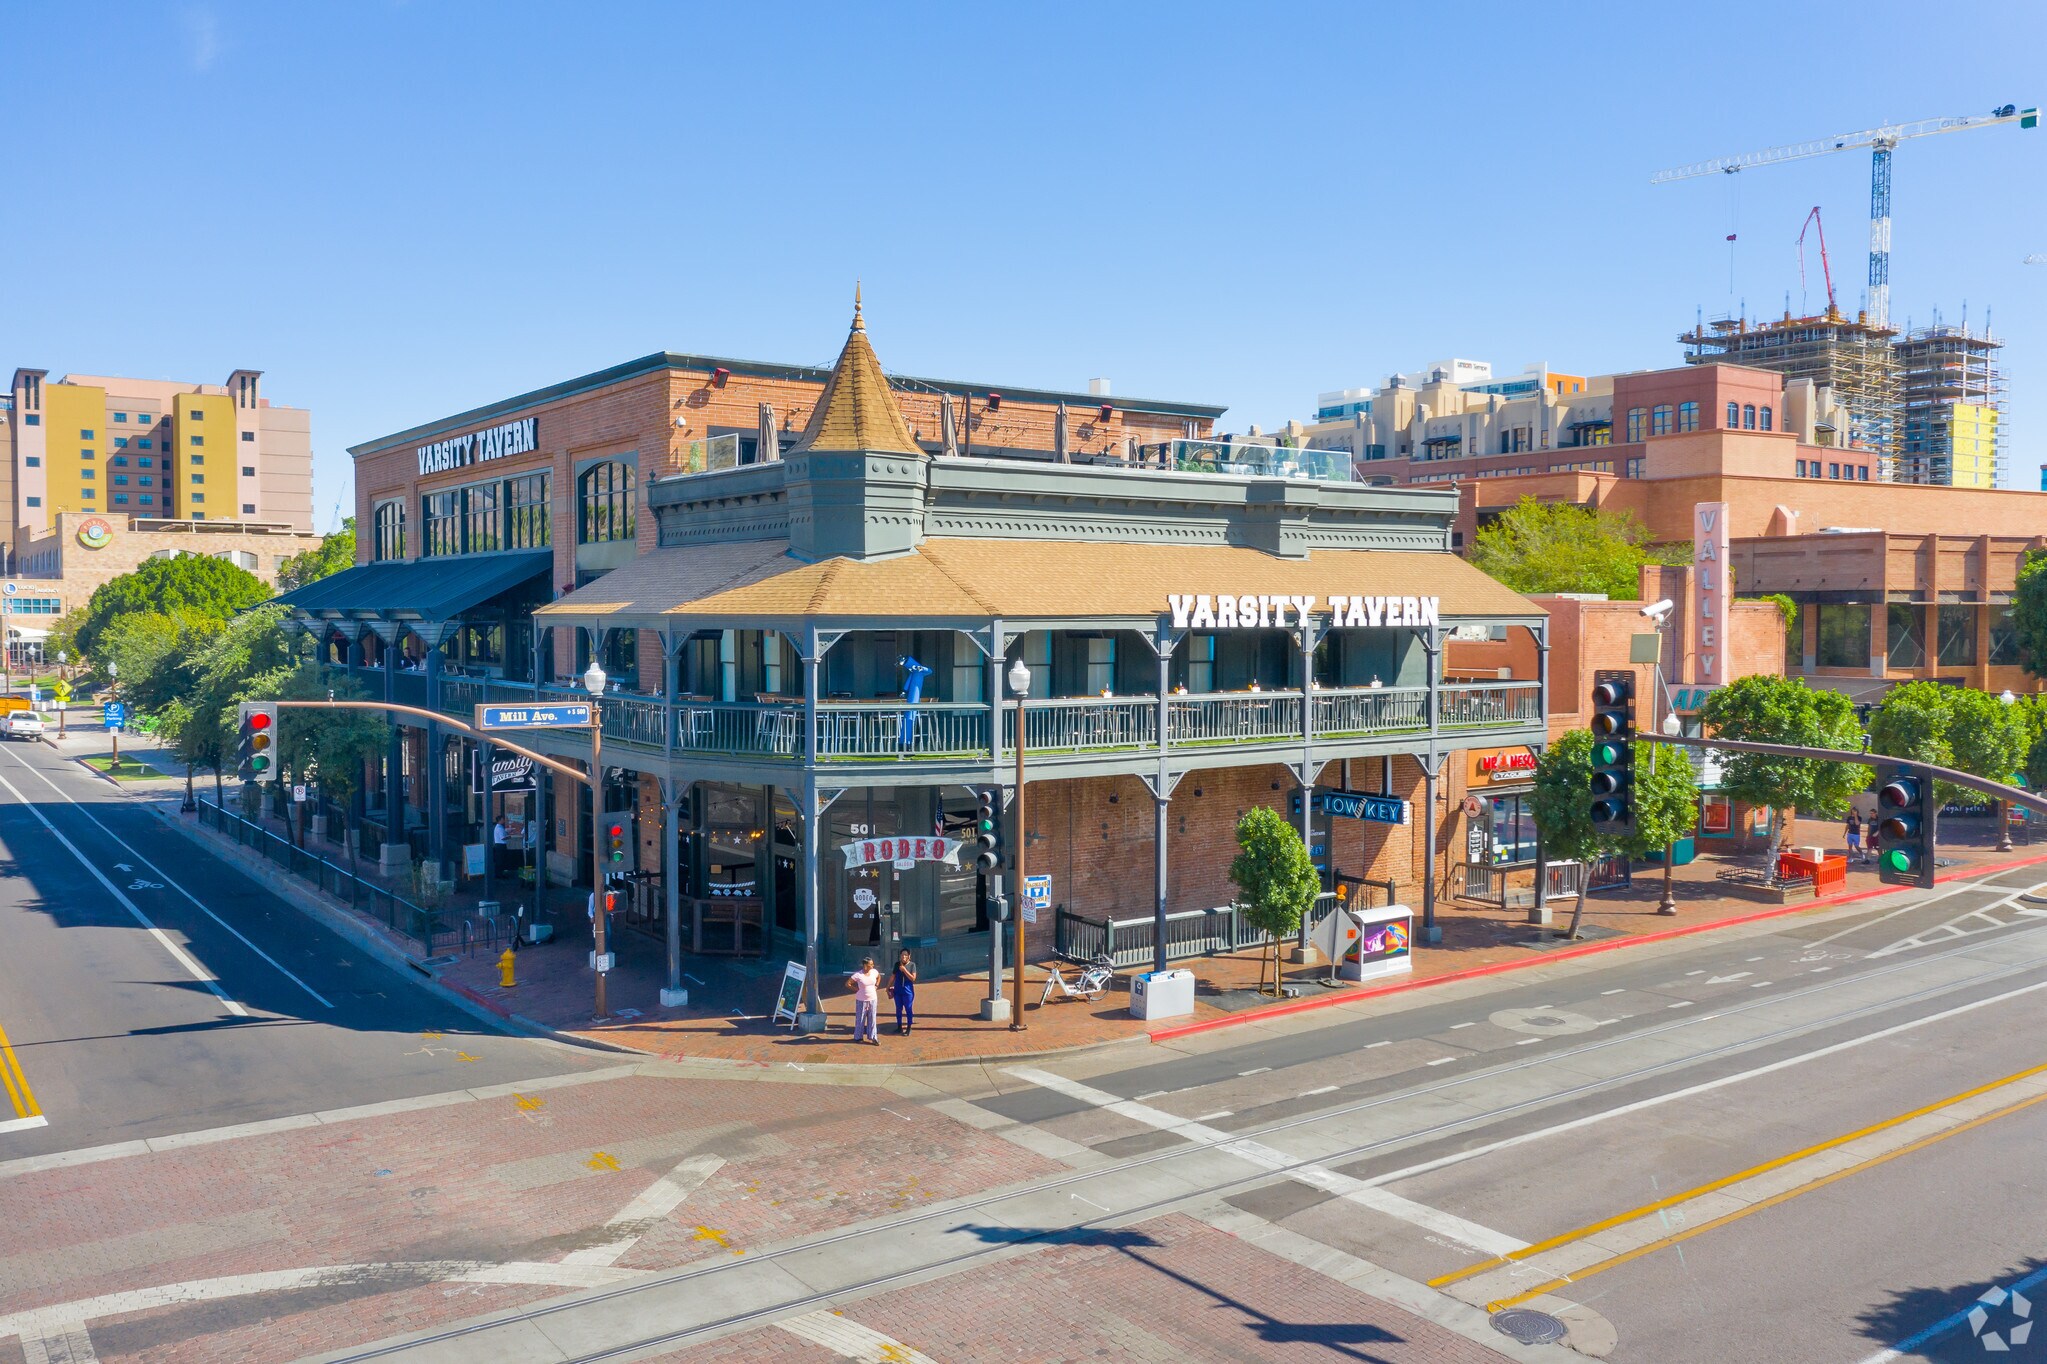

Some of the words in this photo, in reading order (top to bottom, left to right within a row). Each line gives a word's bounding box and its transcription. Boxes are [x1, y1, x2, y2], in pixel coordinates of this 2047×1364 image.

[418, 434, 473, 475] VARSITY
[477, 418, 535, 462] TAVERN
[83, 520, 109, 530] PUBLIC
[1699, 511, 1717, 676] VALLEY
[1167, 594, 1316, 628] VARSITY
[1327, 595, 1440, 627] TAVERN
[1673, 689, 1709, 710] AR
[500, 711, 527, 721] Mill
[532, 711, 558, 721] Ave.
[492, 755, 533, 776] arsity
[1943, 805, 1962, 814] legal
[1965, 803, 1986, 814] pete's
[863, 838, 945, 862] RODEO
